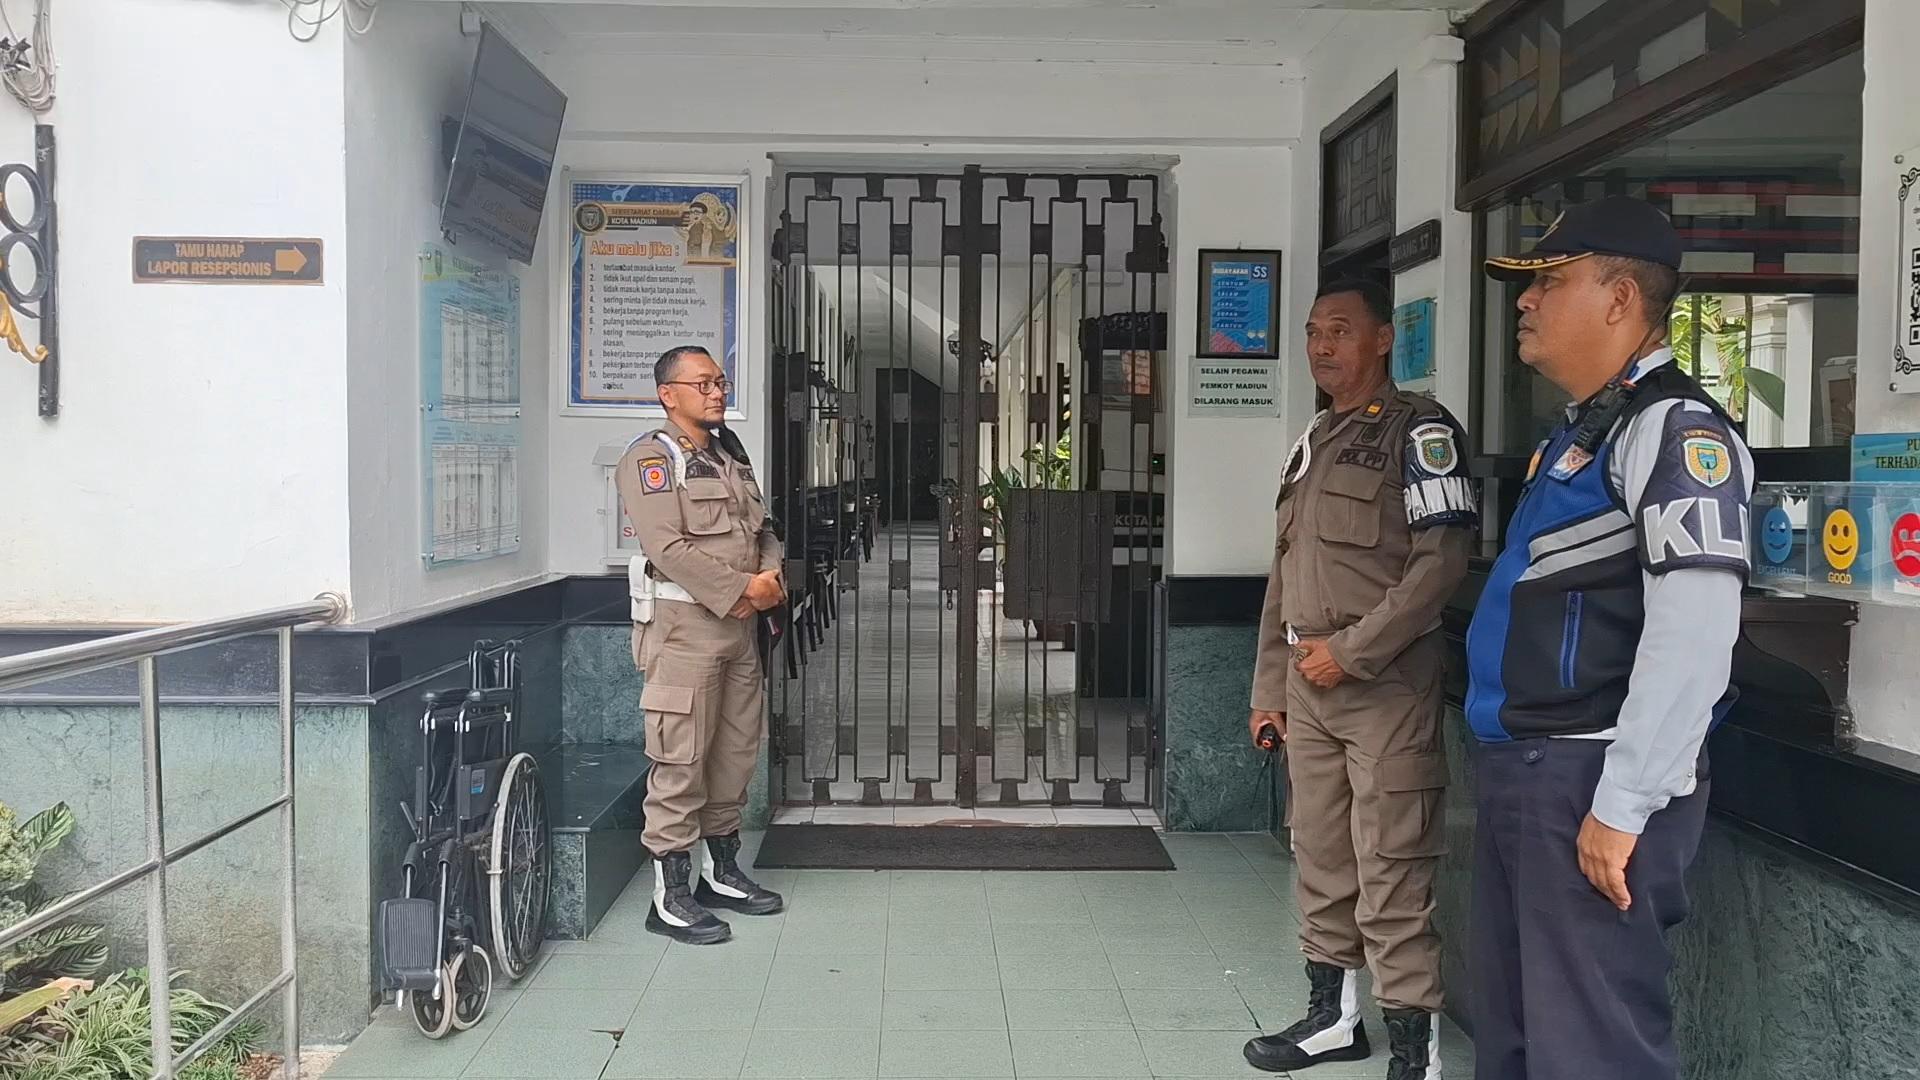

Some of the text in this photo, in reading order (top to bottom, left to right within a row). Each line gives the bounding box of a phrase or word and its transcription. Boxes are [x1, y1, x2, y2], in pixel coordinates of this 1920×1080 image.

[175, 243, 245, 258] TAMU HARAP
[590, 240, 614, 255] Aku
[617, 241, 648, 255] malu
[648, 241, 672, 259] jika
[148, 261, 272, 276] LAPOR RESEPSIONIS
[1252, 266, 1268, 278] 5S
[603, 274, 619, 282] tidak
[632, 275, 645, 283] apel
[641, 286, 656, 295] kerja
[657, 287, 674, 295] tanpa
[603, 297, 623, 305] sering
[603, 307, 626, 316] bekerja
[645, 308, 671, 317] program
[603, 318, 625, 327] pulang
[626, 318, 652, 326] sebelum
[603, 329, 623, 338] sering
[673, 329, 694, 337] kantor
[697, 330, 715, 339] tanpa
[602, 349, 626, 358] bekerja
[627, 351, 644, 359] tanpa
[602, 372, 637, 380] berpakaian
[1875, 455, 1920, 469] TERHAD
[1828, 571, 1852, 585] GOOD
